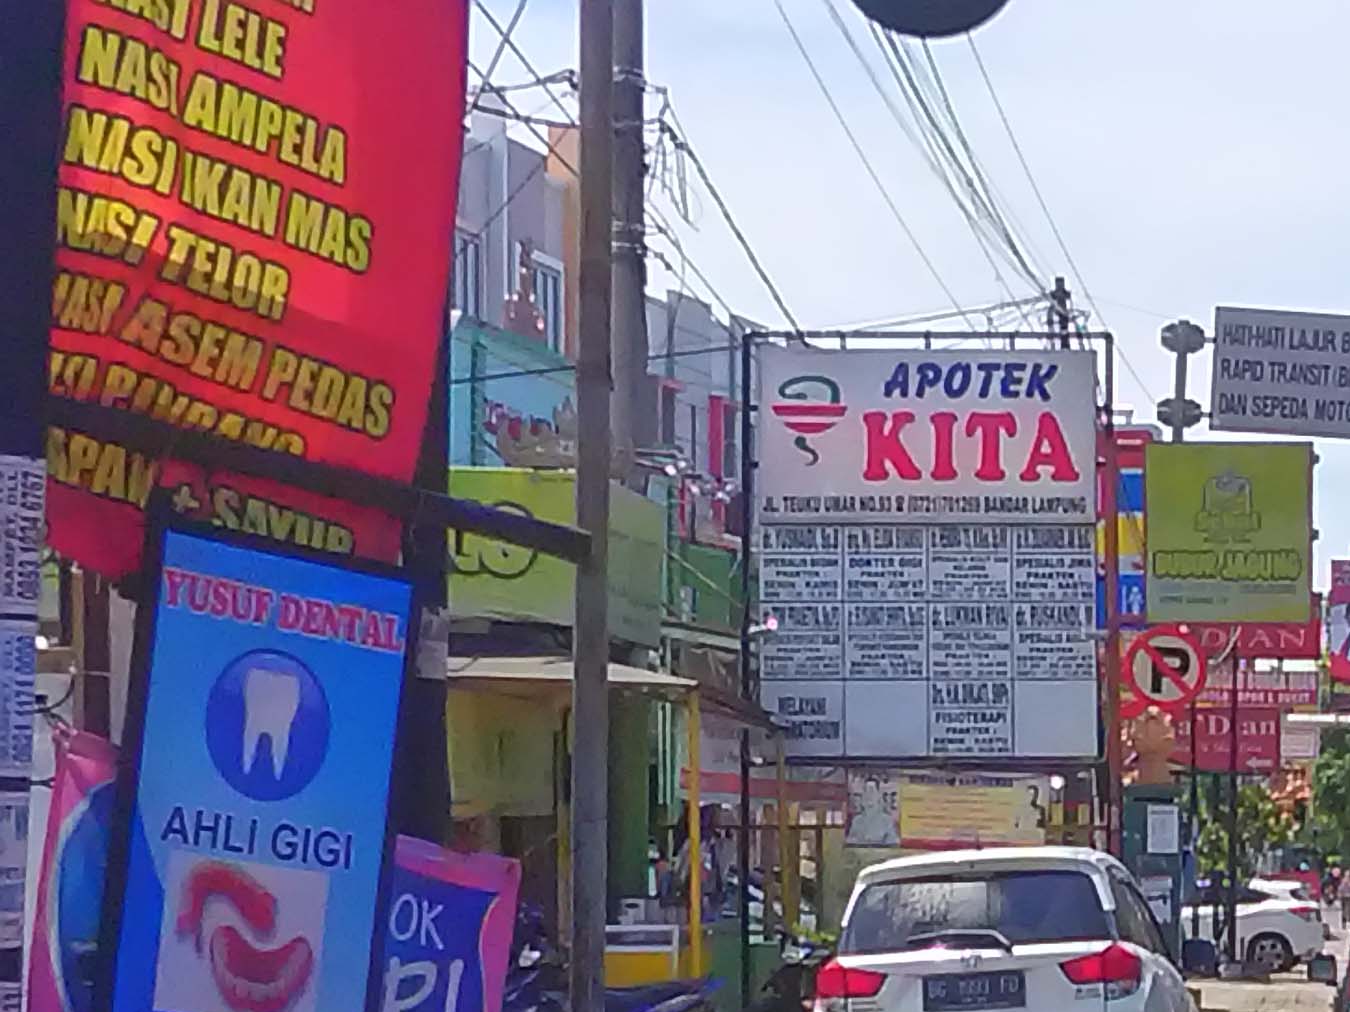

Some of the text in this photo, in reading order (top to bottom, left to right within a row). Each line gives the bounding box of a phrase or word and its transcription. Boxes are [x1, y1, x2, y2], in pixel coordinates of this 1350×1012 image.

[196, 0, 288, 79] LELE
[78, 23, 347, 185] NASI AMPELA
[181, 151, 282, 237] IKAN
[283, 192, 373, 273] MAS
[161, 225, 291, 320] TELOR
[119, 296, 265, 392] ASEM
[262, 344, 396, 438] PEDAS
[1220, 357, 1264, 382] RAPID
[1267, 361, 1331, 387] TRANSIT
[1288, 328, 1338, 353] LAJUR
[884, 361, 1059, 401] APOTEK
[1218, 391, 1248, 417] DAN
[1251, 395, 1309, 421] SEPEDA
[861, 411, 1080, 482] KITA
[983, 496, 1028, 514] BANDAR
[1031, 496, 1087, 514] LAMPUNG
[162, 568, 404, 653] YUSUF DENTAL
[160, 806, 354, 871] AHLI GIGI
